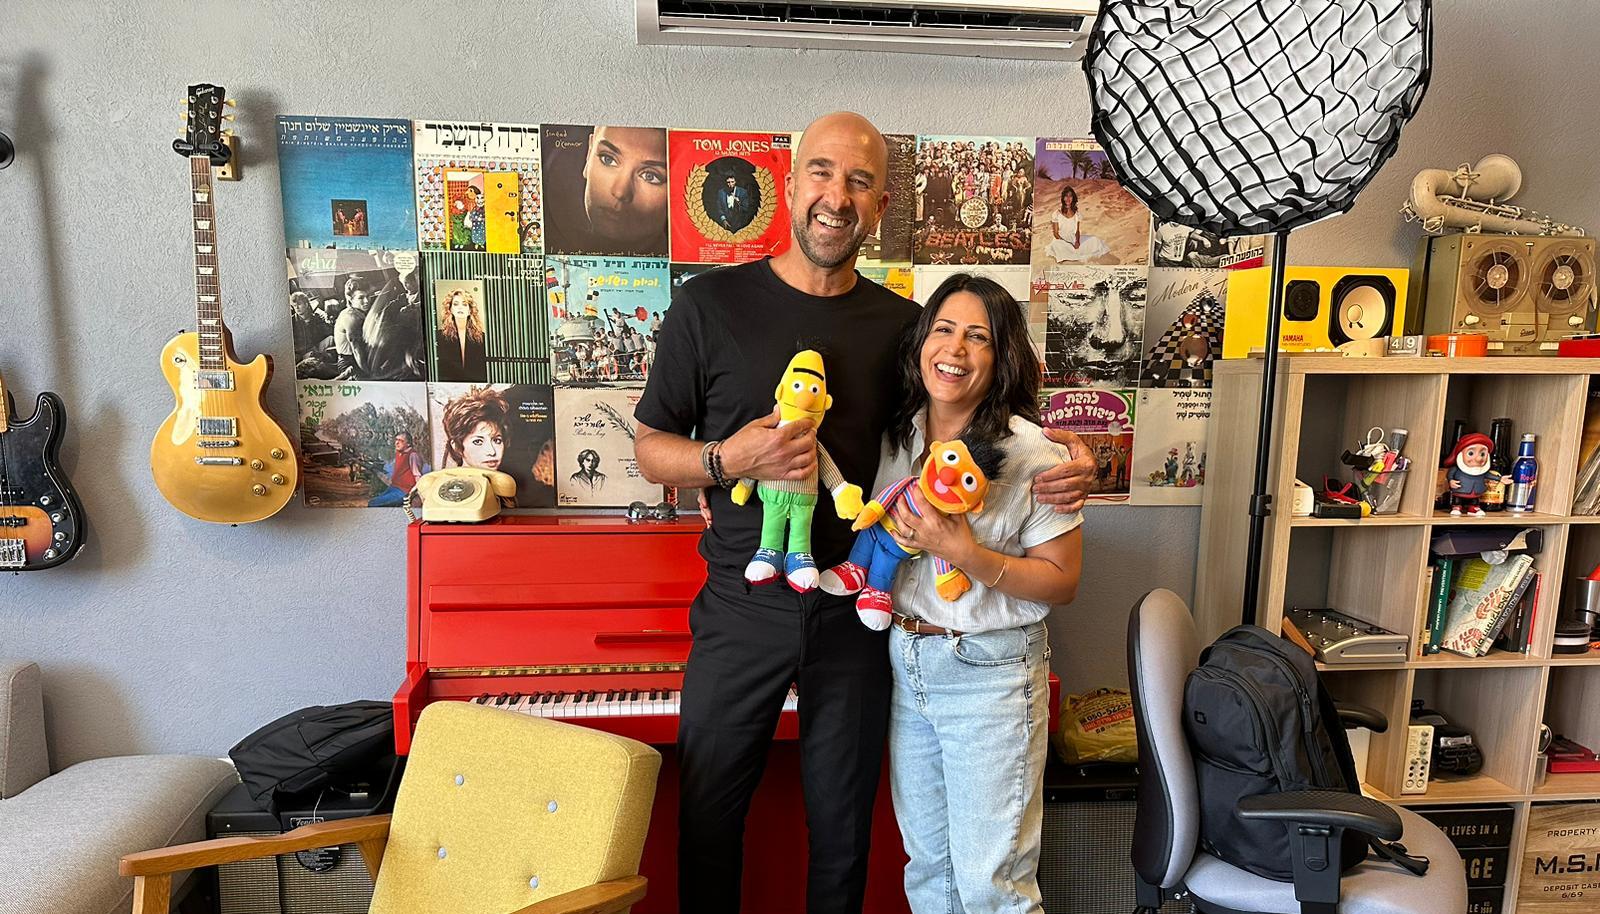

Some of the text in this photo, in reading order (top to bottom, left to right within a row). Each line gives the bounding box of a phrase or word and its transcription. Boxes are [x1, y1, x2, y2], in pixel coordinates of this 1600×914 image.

[279, 117, 407, 136] אריק איינשטיין שלום חנוך
[692, 139, 770, 153] TOM JONES
[925, 231, 1022, 249] BEATLES
[1234, 246, 1264, 262] בהופעה
[603, 259, 626, 268] חיל
[632, 260, 669, 270] להקת
[1152, 279, 1199, 306] Modern
[1282, 334, 1304, 342] YAMAHA
[303, 384, 362, 397] יוסי בנאי
[1193, 390, 1212, 401] חתול
[1064, 391, 1100, 404] להקת
[1084, 404, 1116, 420] פיקוד
[1519, 473, 1534, 482] Red
[1451, 824, 1477, 836] LIVES
[1480, 824, 1490, 835] IN
[1493, 824, 1499, 834] A
[1547, 827, 1597, 838] PROPERTY
[1543, 883, 1579, 892] DEPOSIT
[1561, 891, 1583, 899] 6/69
